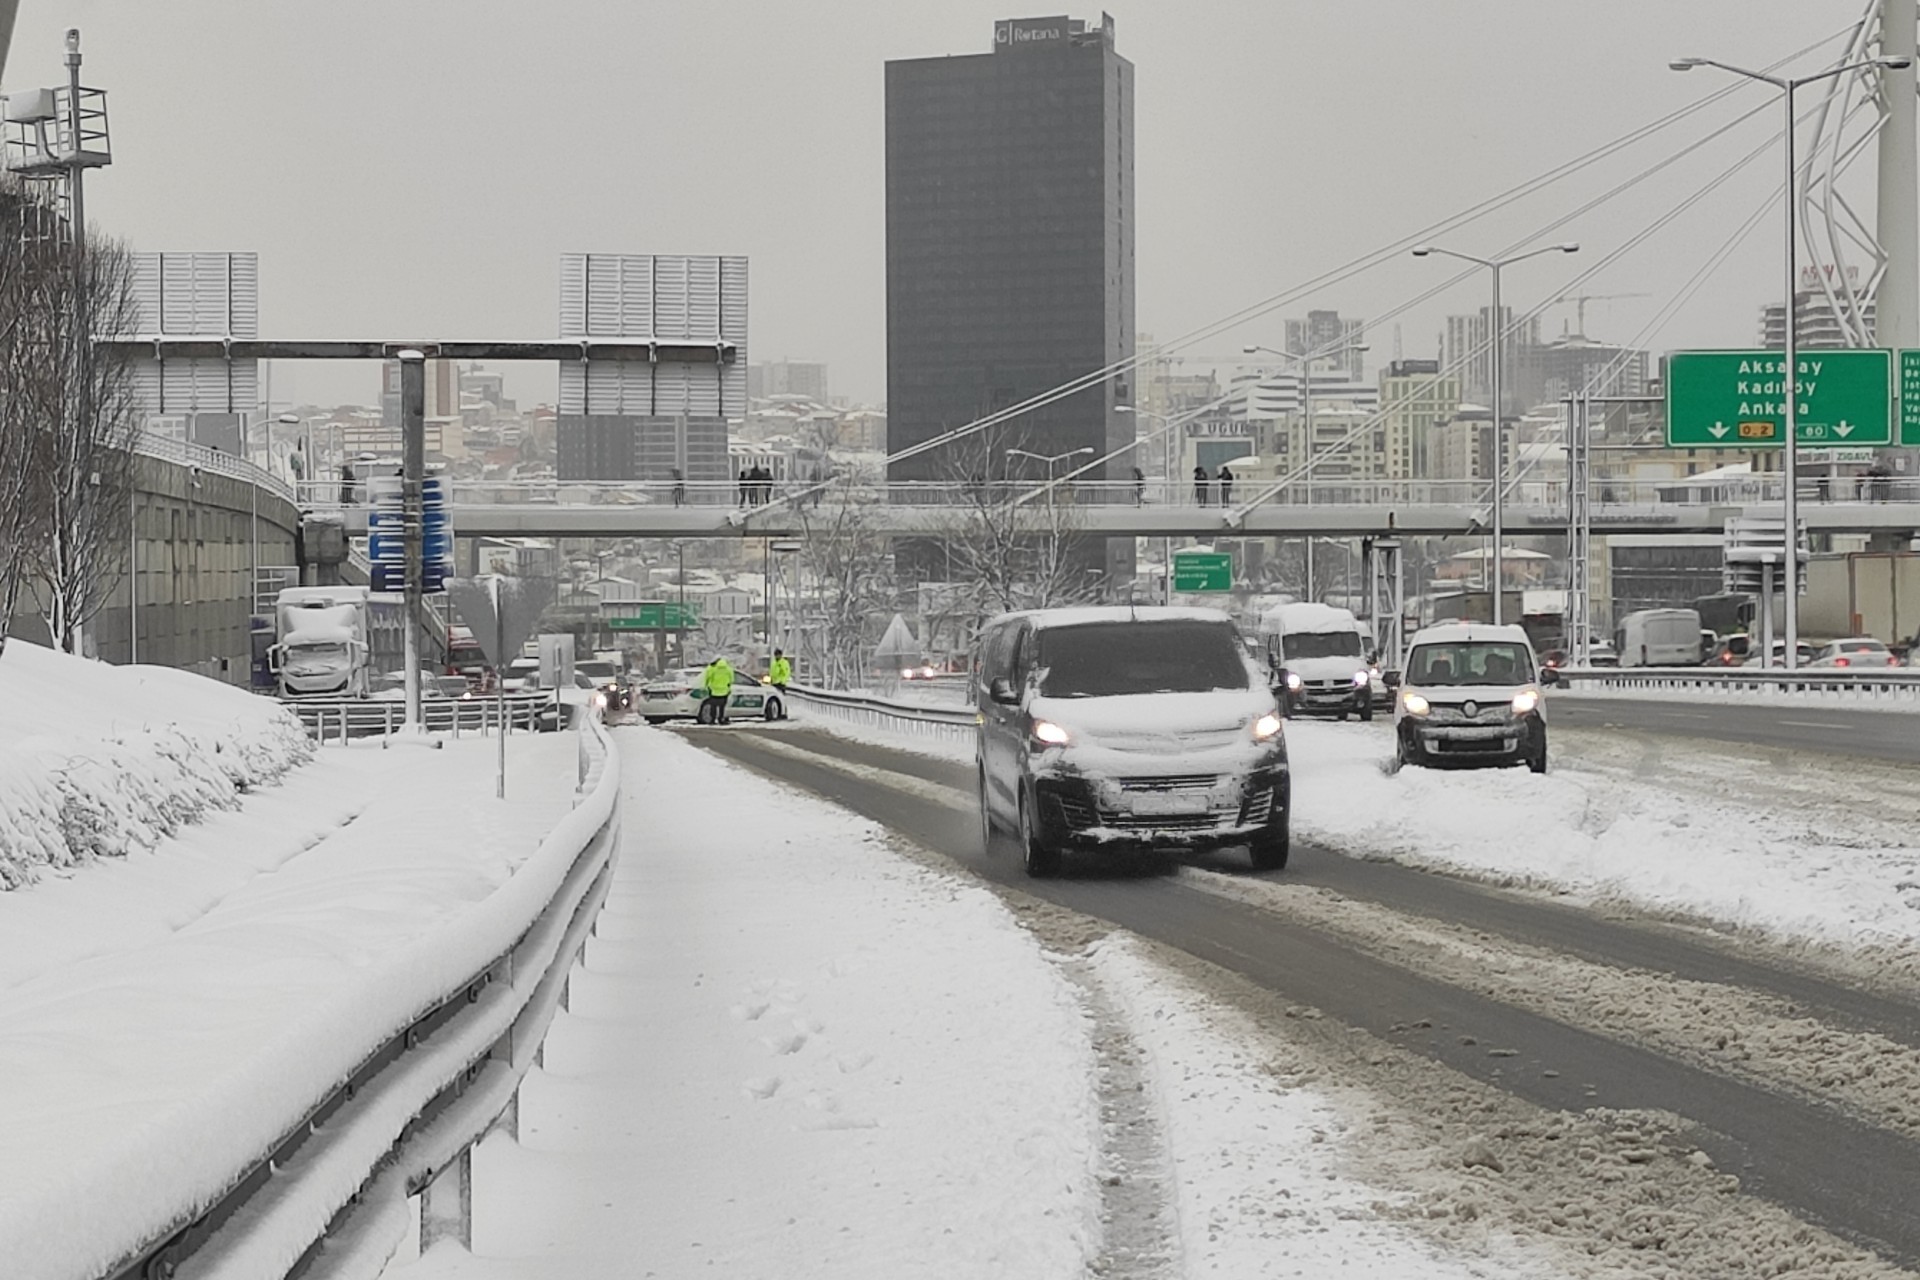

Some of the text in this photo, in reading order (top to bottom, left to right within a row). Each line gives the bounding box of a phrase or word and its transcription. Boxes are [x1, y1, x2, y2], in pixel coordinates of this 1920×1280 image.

[1738, 360, 1822, 376] Aksaay
[1737, 380, 1816, 396] Kadıöy
[1738, 402, 1809, 415] Ankaa
